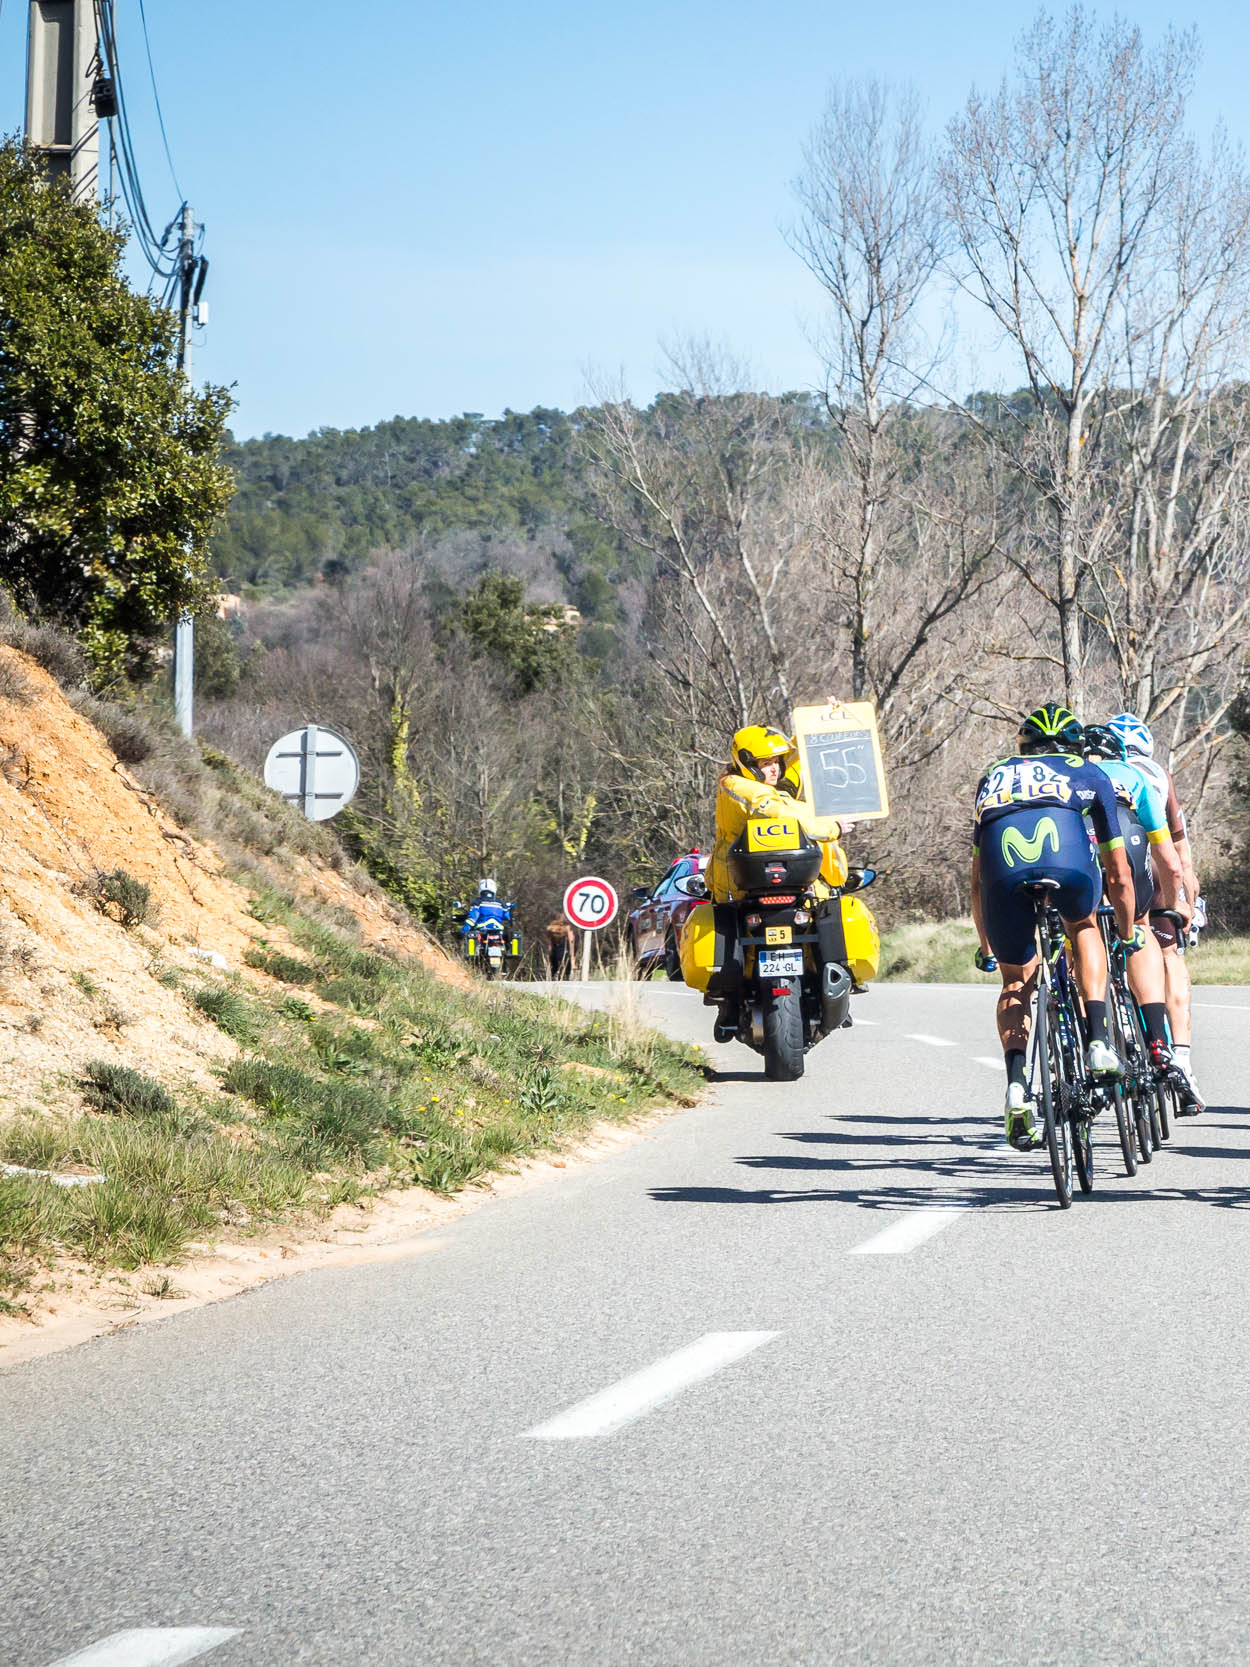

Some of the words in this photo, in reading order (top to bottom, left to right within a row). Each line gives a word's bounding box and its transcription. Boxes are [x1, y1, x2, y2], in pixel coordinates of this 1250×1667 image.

[1029, 783, 1064, 800] LCL
[757, 824, 795, 837] LCL
[579, 892, 605, 914] 70
[779, 930, 786, 940] 5
